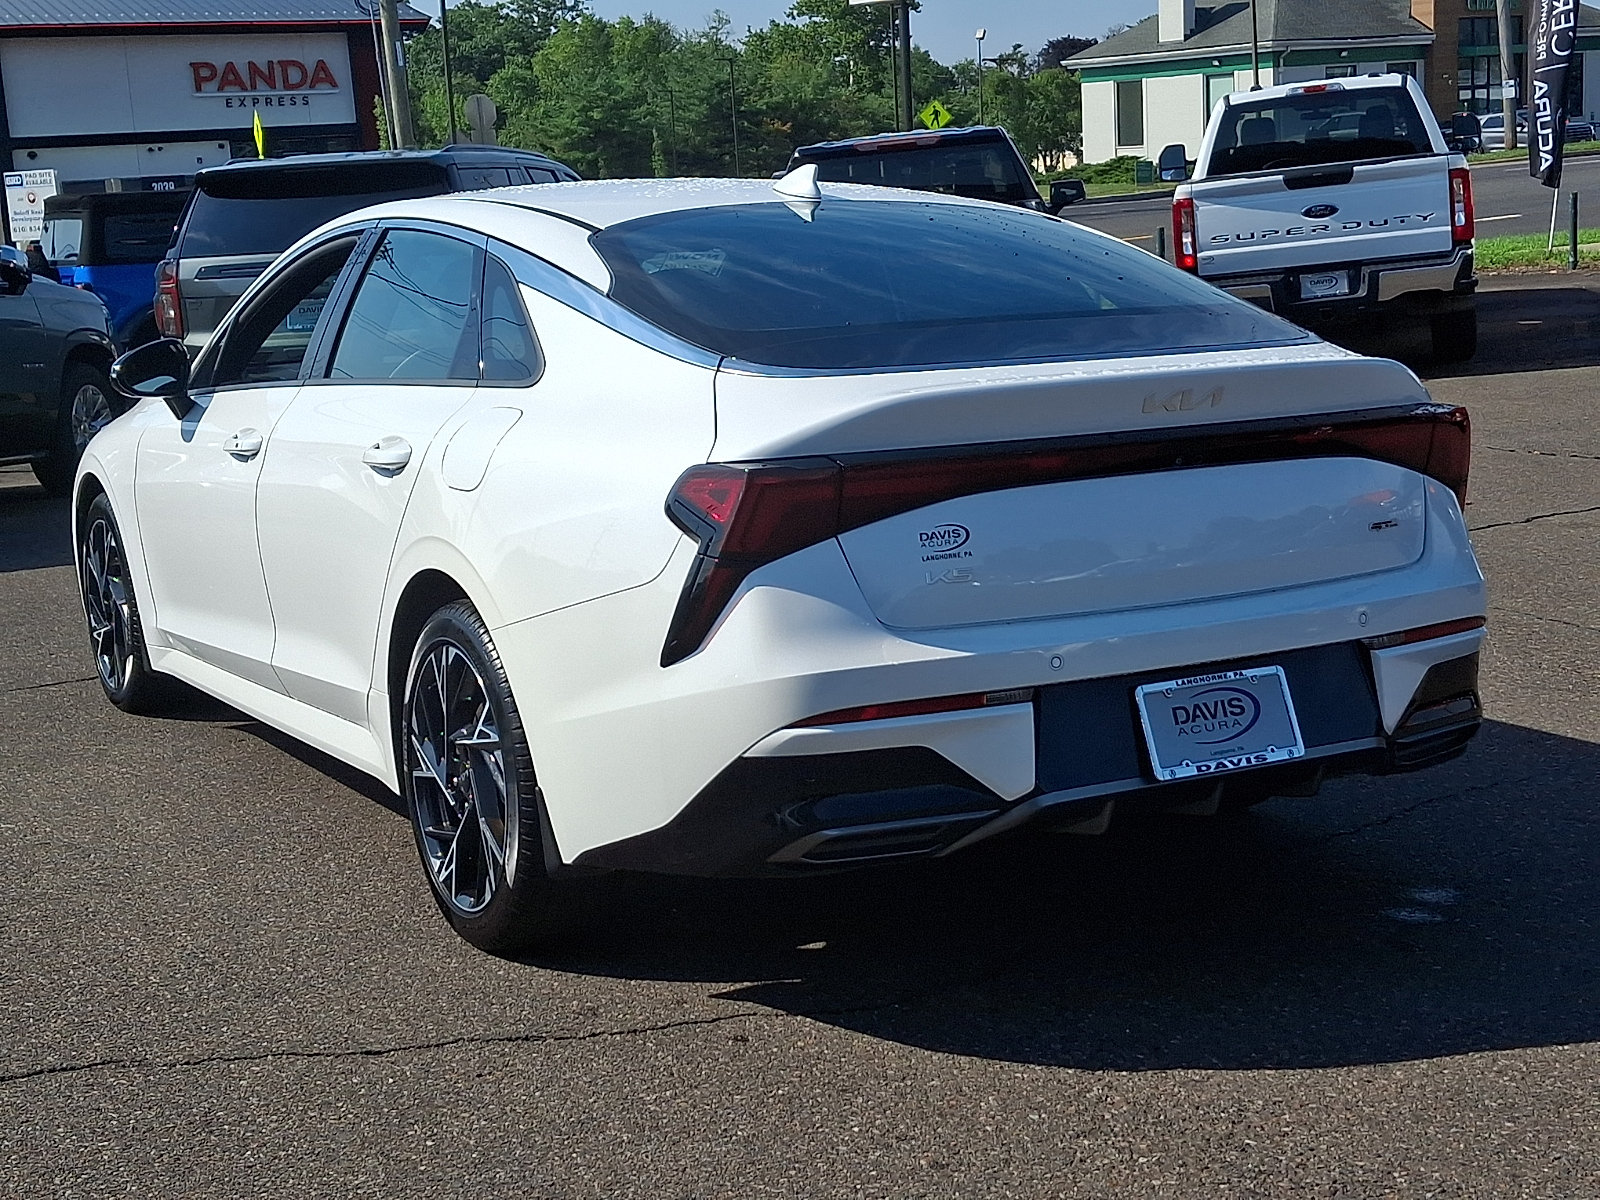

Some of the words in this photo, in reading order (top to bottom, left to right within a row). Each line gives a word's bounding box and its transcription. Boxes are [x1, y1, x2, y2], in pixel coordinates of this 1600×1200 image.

[189, 59, 339, 92] PANDA
[225, 96, 310, 108] EXPRESS
[1210, 224, 1331, 244] SUPER
[1342, 212, 1436, 230] DUTY
[1309, 277, 1334, 287] DAVIS
[919, 528, 962, 542] DAVIS
[920, 539, 960, 548] ACURA
[963, 550, 973, 558] PA
[925, 566, 973, 585] K5
[1171, 696, 1247, 726] DAVIS
[1177, 718, 1244, 737] ACURA
[1195, 754, 1269, 773] DAVIS
